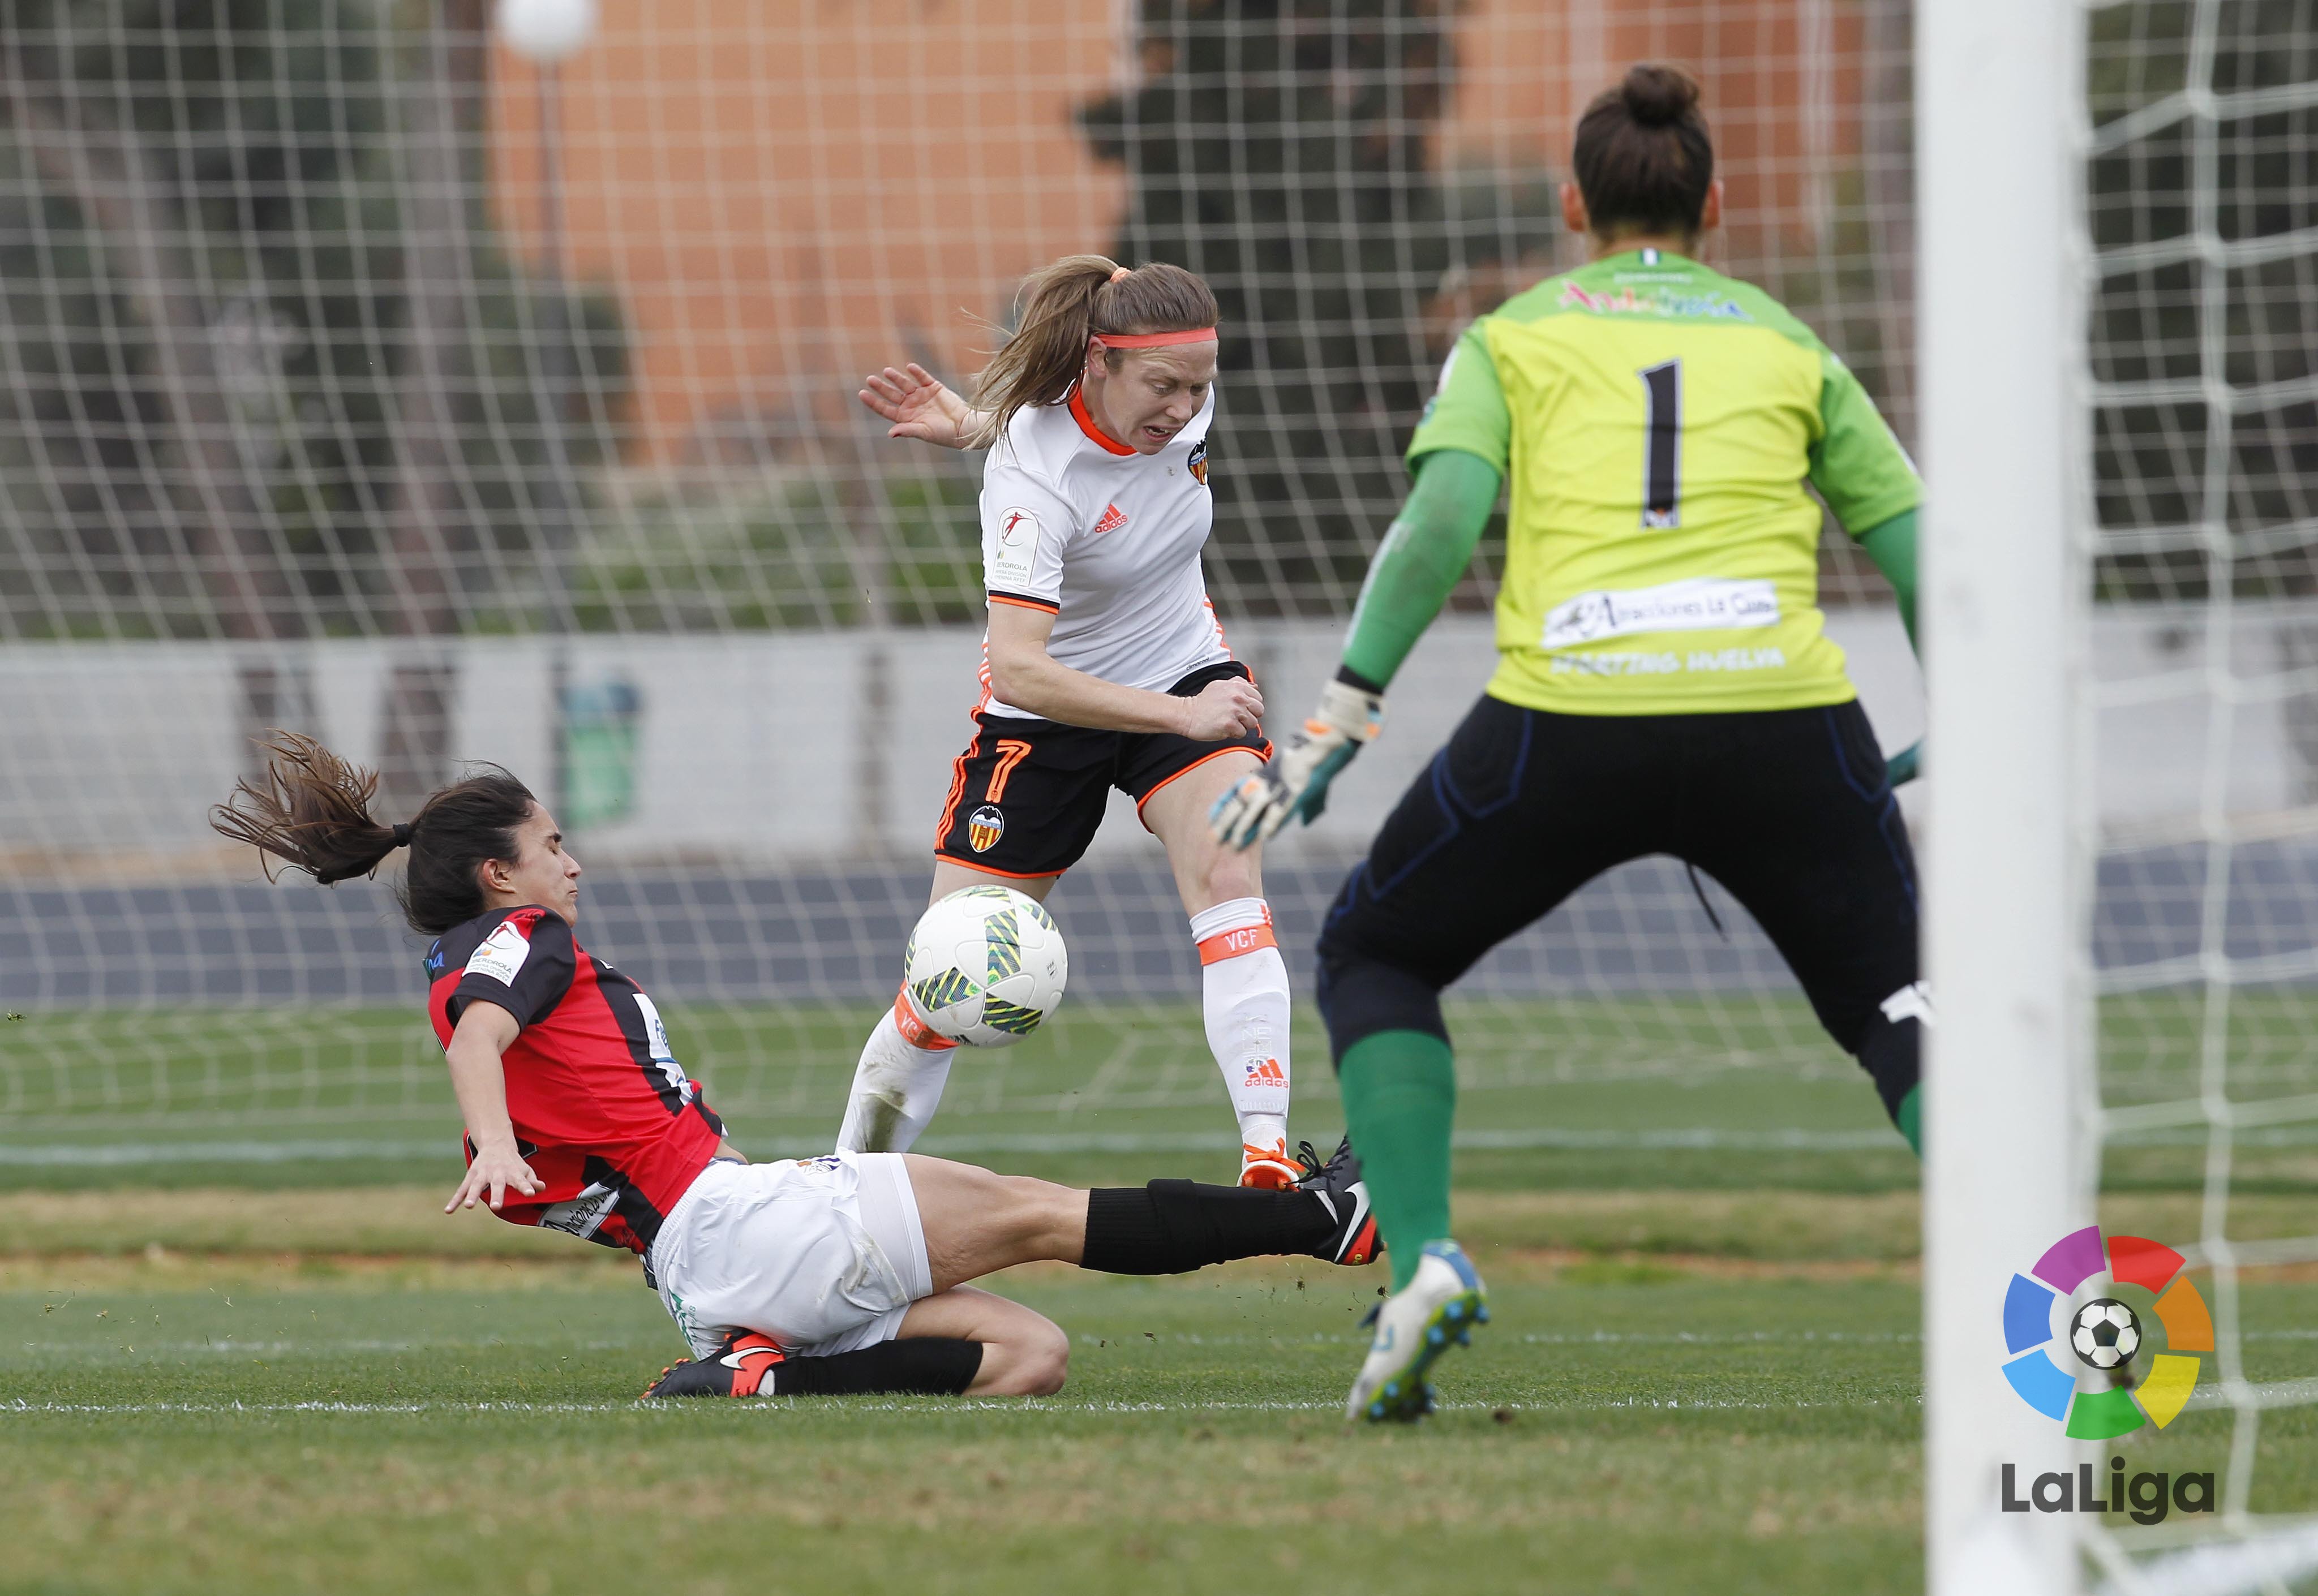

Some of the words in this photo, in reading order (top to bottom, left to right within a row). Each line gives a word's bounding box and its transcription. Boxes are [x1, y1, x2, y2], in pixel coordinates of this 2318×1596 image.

[1635, 355, 1685, 531] 1
[1094, 513, 1128, 534] adidas
[985, 739, 1032, 804] 7
[1225, 928, 1258, 952] VCF
[1244, 1076, 1289, 1089] adidas
